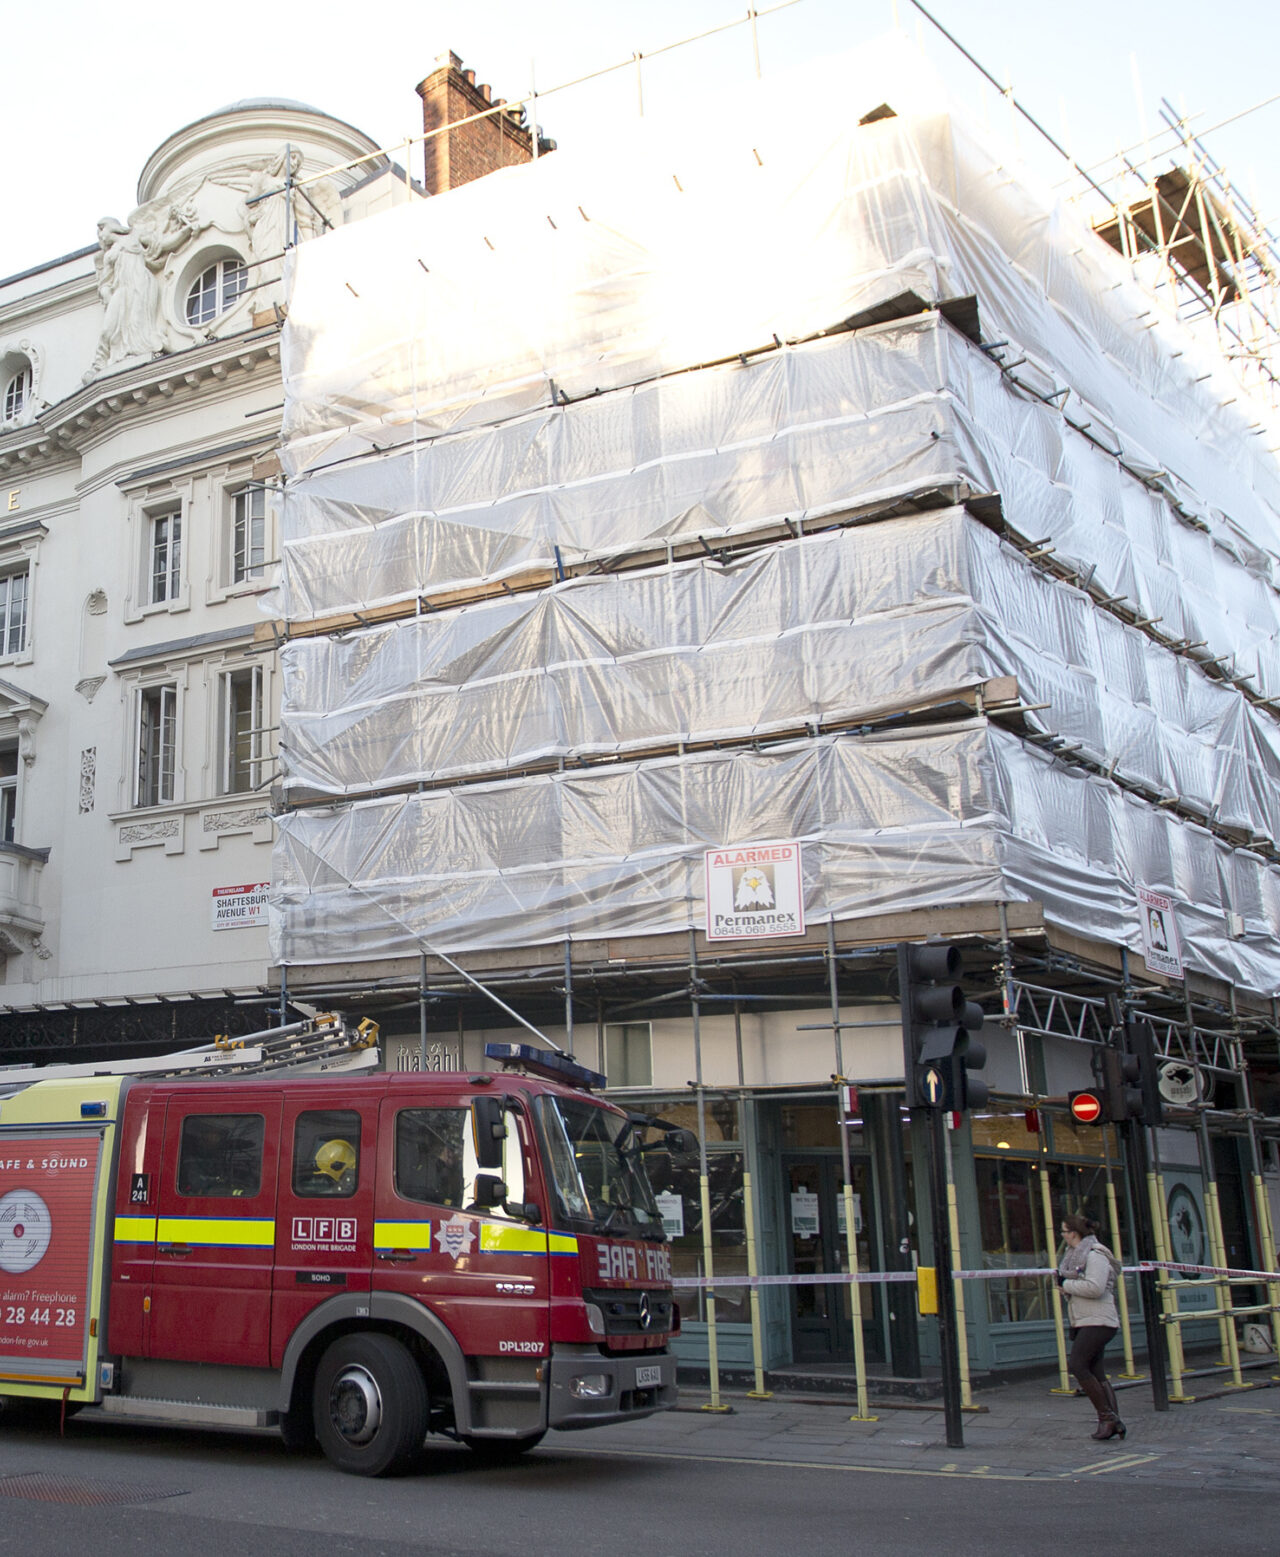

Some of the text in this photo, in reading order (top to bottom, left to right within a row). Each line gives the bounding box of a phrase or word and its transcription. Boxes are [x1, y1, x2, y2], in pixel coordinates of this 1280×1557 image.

[714, 848, 792, 865] ALARMED
[217, 906, 260, 919] AVENUE W1
[716, 912, 795, 927] Permanex
[714, 922, 797, 936] 0845 069 5555
[26, 1160, 35, 1169] &
[42, 1158, 88, 1169] SOUND
[137, 1178, 143, 1188] A
[132, 1190, 147, 1201] 241
[298, 1221, 352, 1238] LFB
[330, 1244, 356, 1252] BRIGADE
[646, 1250, 671, 1281] FIRE
[312, 1274, 331, 1282] SOHO
[3, 1290, 30, 1301] alarm?
[32, 1291, 77, 1305] Freephone
[6, 1307, 25, 1324] 28
[30, 1308, 50, 1325] 44
[56, 1309, 75, 1326] 28
[499, 1341, 544, 1352] DPL1207
